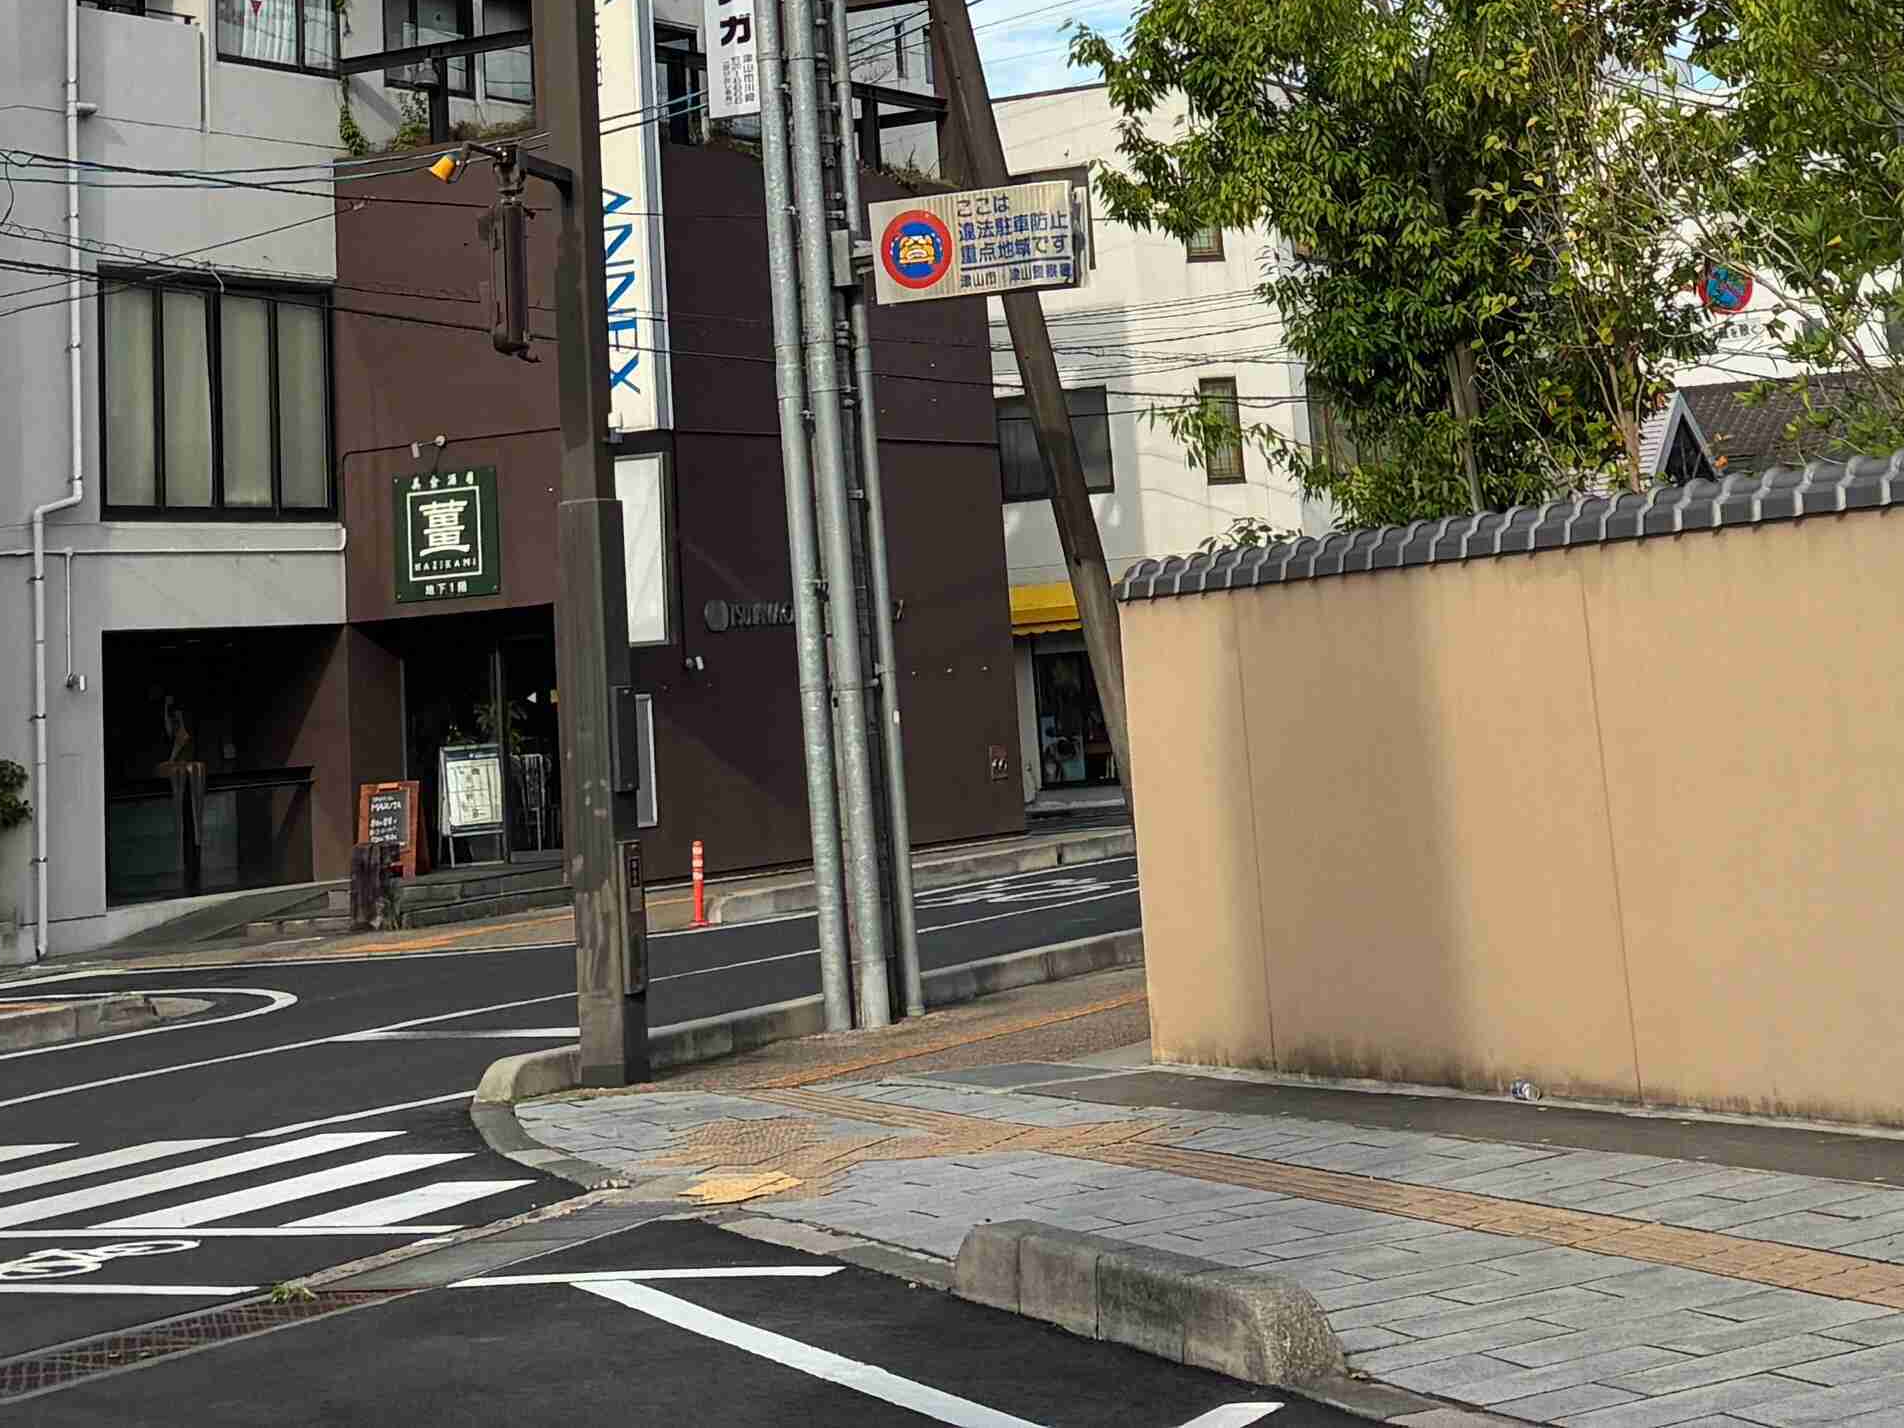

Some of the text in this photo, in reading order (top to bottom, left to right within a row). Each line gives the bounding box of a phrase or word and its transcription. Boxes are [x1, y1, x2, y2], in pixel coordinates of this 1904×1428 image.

[957, 193, 1009, 217] ここは
[959, 211, 1068, 242] 違法駐車防止
[961, 234, 1068, 265] 重点地域です
[602, 188, 641, 394] ANNEX
